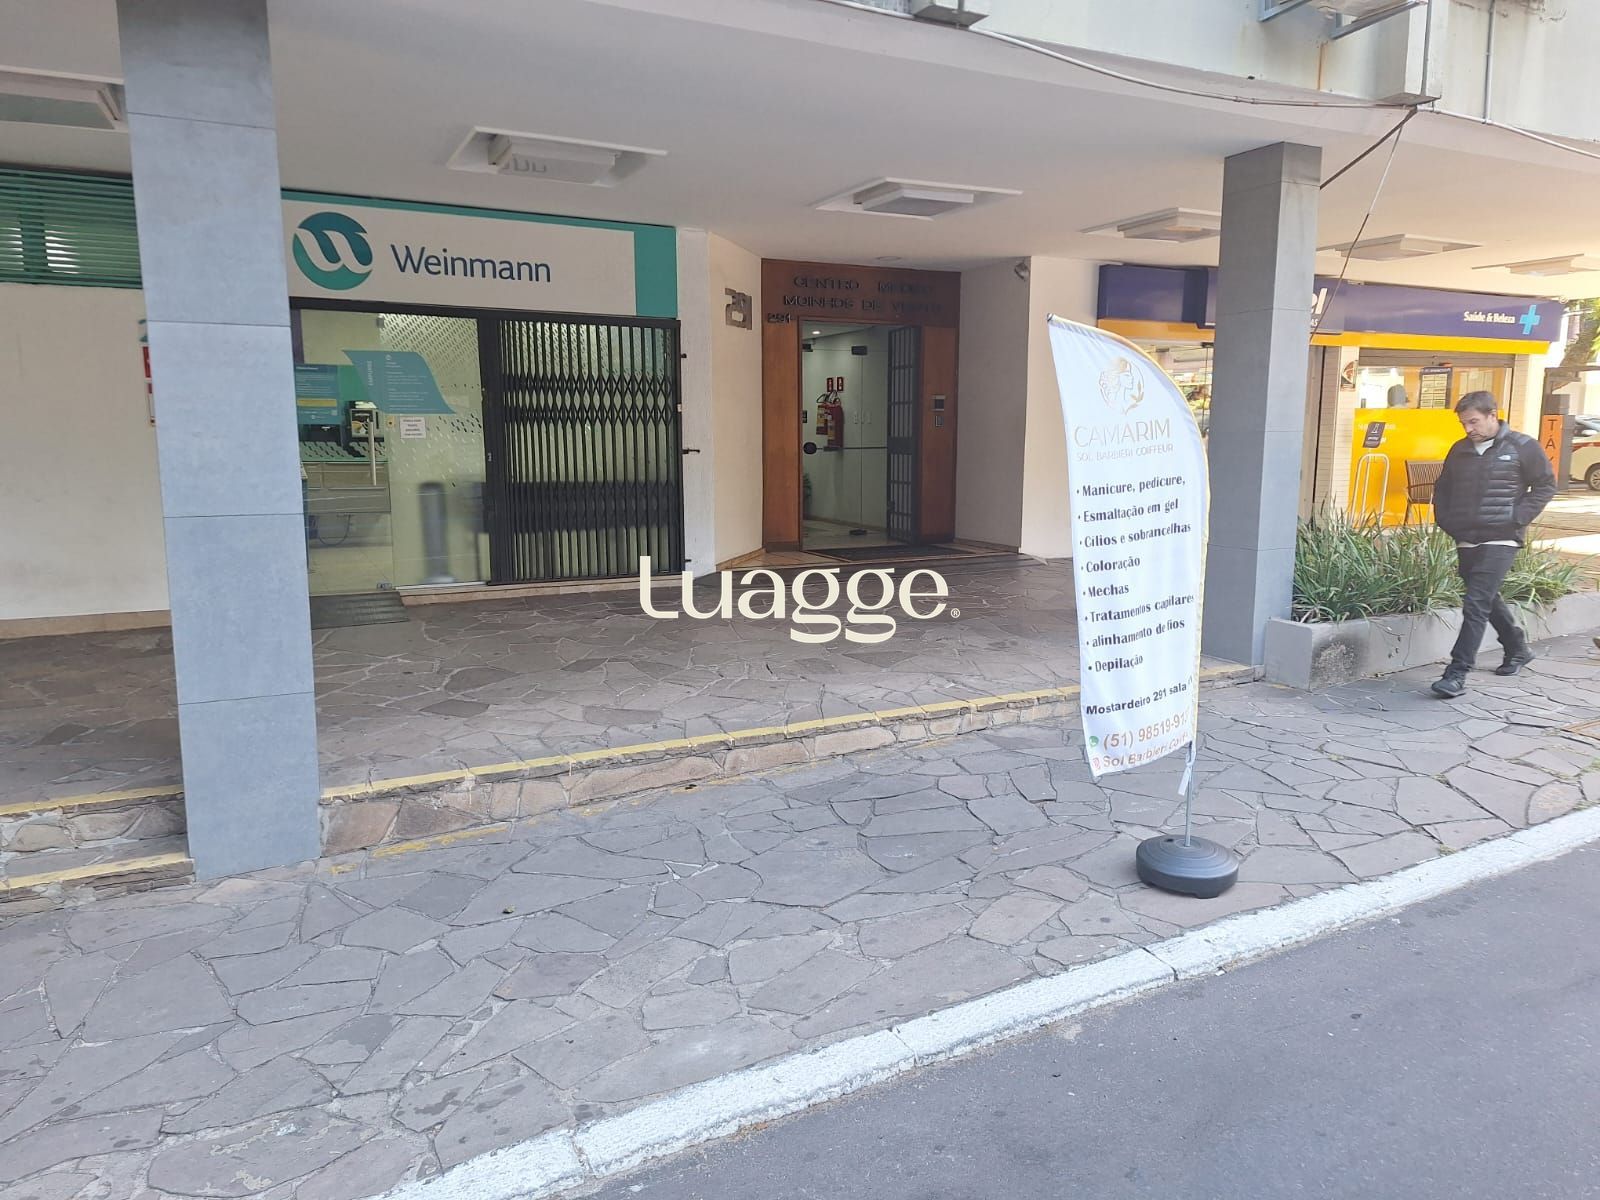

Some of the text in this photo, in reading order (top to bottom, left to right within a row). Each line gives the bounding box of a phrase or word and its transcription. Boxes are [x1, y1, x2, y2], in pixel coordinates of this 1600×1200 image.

[390, 243, 551, 283] Weinmann
[793, 276, 860, 291] CENTRO
[1074, 418, 1170, 448] CAMARIM
[1135, 443, 1174, 456] COIFFEUR
[1082, 475, 1186, 497] Manicure, pedicure,
[1083, 498, 1179, 523] Esmaltação em gel
[1120, 534, 1126, 543] e
[1128, 522, 1192, 543] sobrancelhas
[1086, 556, 1141, 573] Coloração
[1088, 584, 1130, 597] Mechas
[1090, 603, 1151, 622] Tratamentos
[1092, 619, 1185, 647] alinhamento de fios
[1095, 654, 1144, 673] Depilação
[1086, 682, 1187, 715] Mostardeiro 291 sala
[1103, 711, 1189, 751] (51) 98519-91
[1103, 755, 1125, 768] Sol
